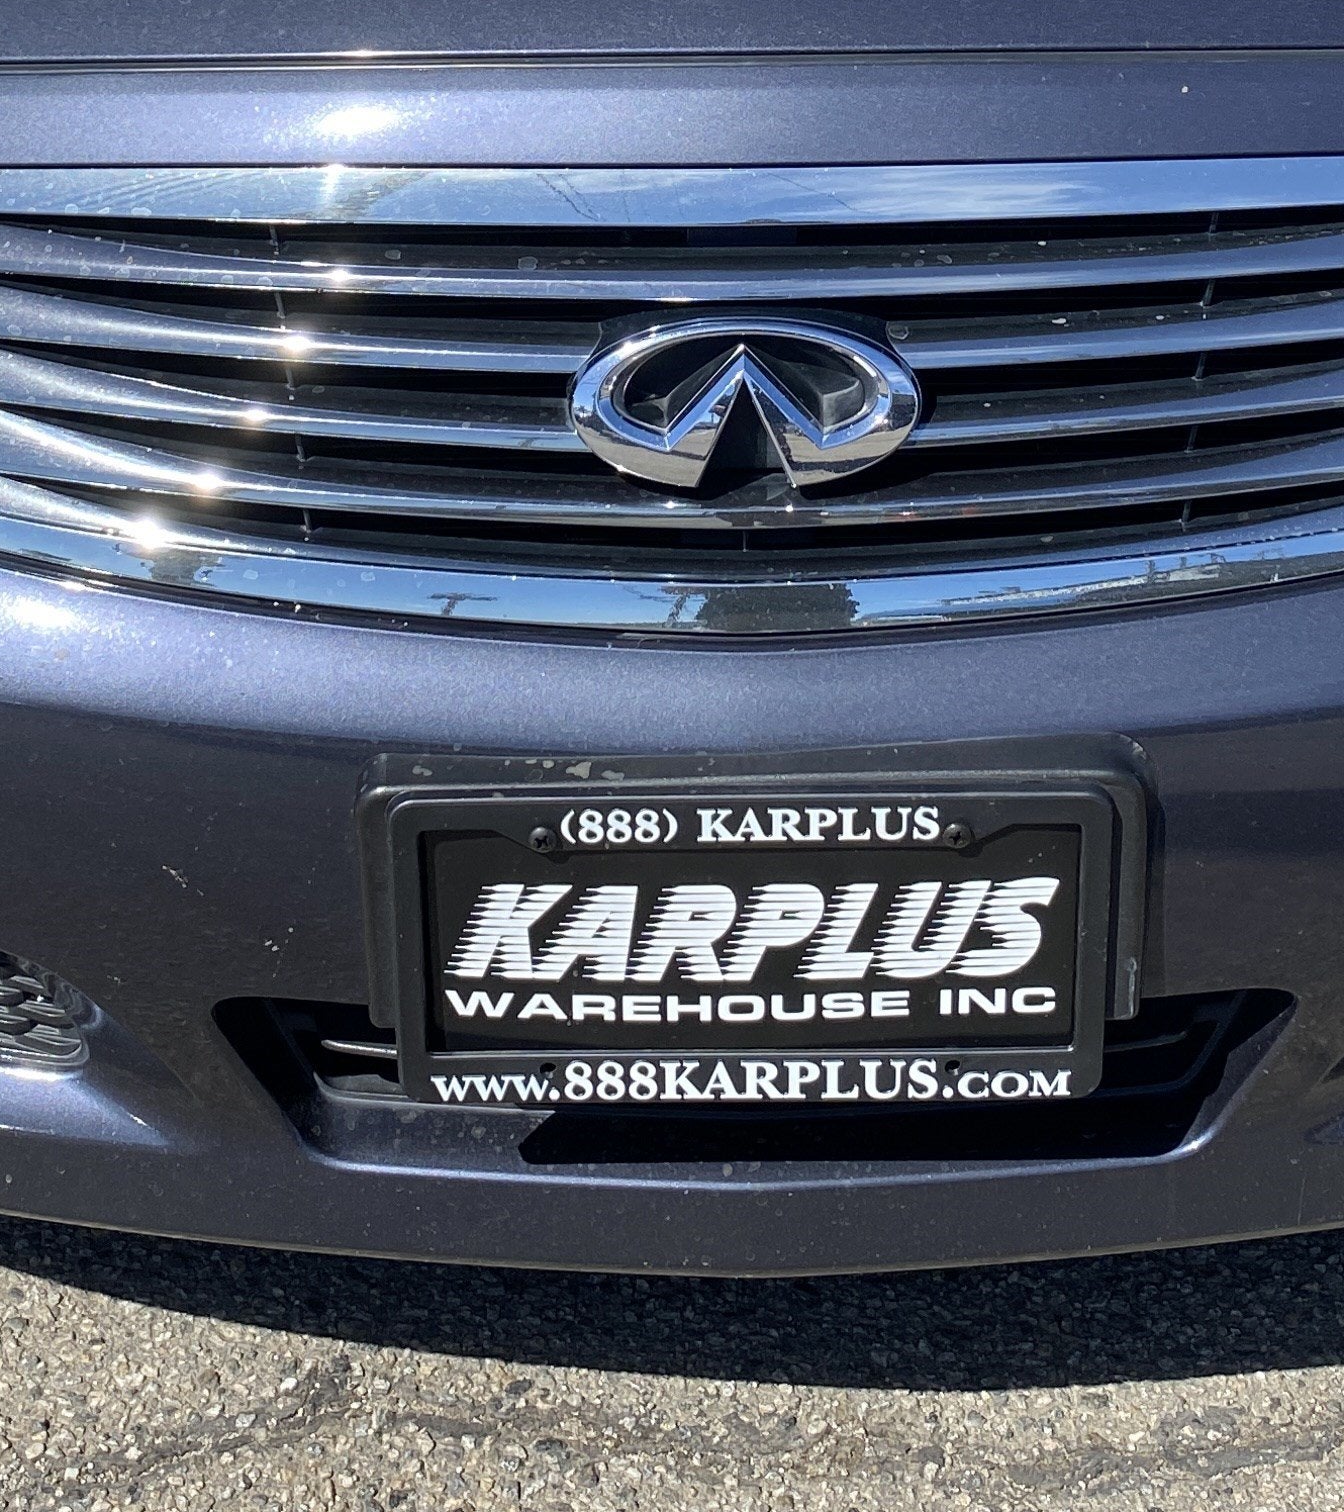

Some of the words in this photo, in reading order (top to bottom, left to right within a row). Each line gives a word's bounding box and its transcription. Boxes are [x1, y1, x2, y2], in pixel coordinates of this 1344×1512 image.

[559, 807, 678, 845] (888)
[695, 805, 941, 842] KARPLUS
[443, 876, 1060, 983] KARPLUS
[444, 989, 910, 1022] WAREHOUSE
[939, 987, 1056, 1015] INC
